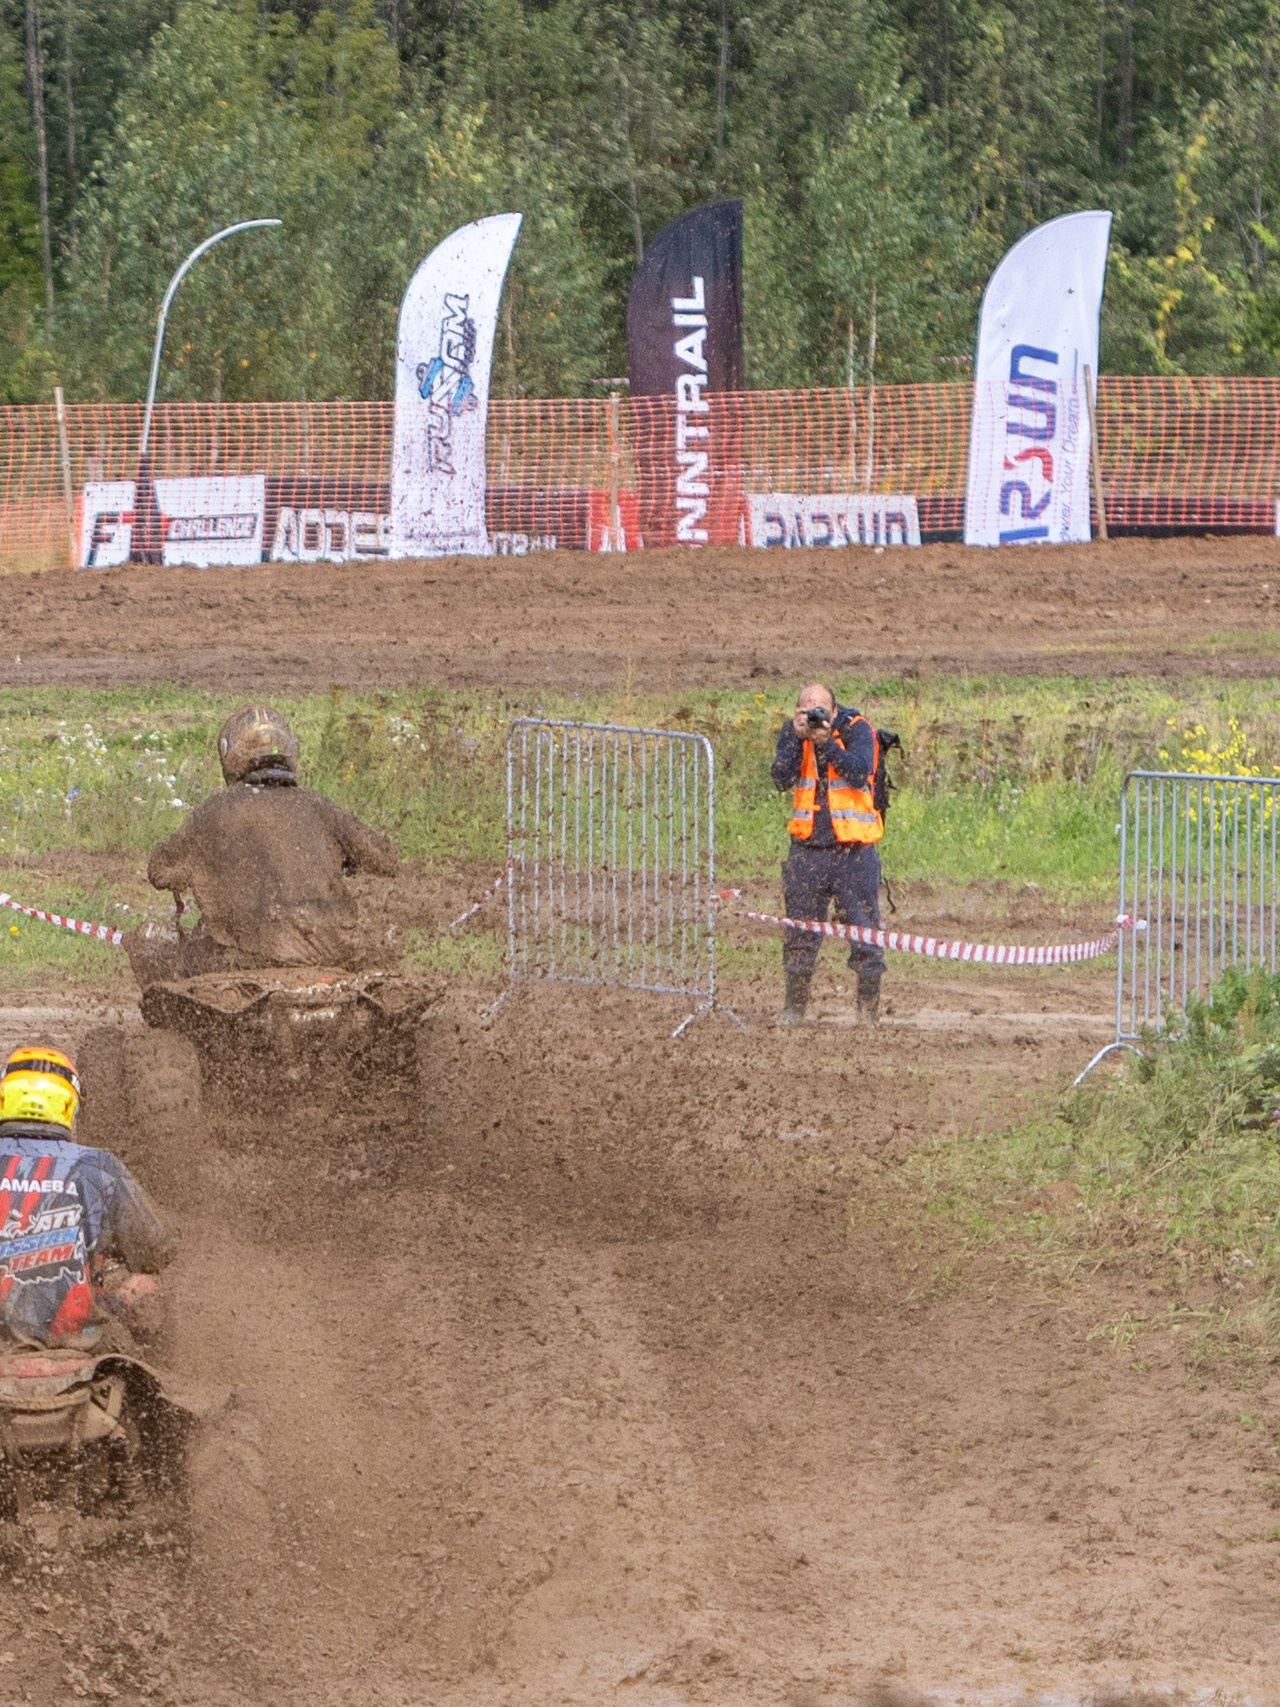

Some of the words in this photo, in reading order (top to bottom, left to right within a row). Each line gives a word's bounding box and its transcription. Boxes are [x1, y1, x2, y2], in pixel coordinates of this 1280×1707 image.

[671, 276, 710, 548] NNTRAIL
[66, 1181, 79, 1197] Д
[33, 1204, 83, 1235] ATV
[10, 1243, 75, 1273] TEAM
